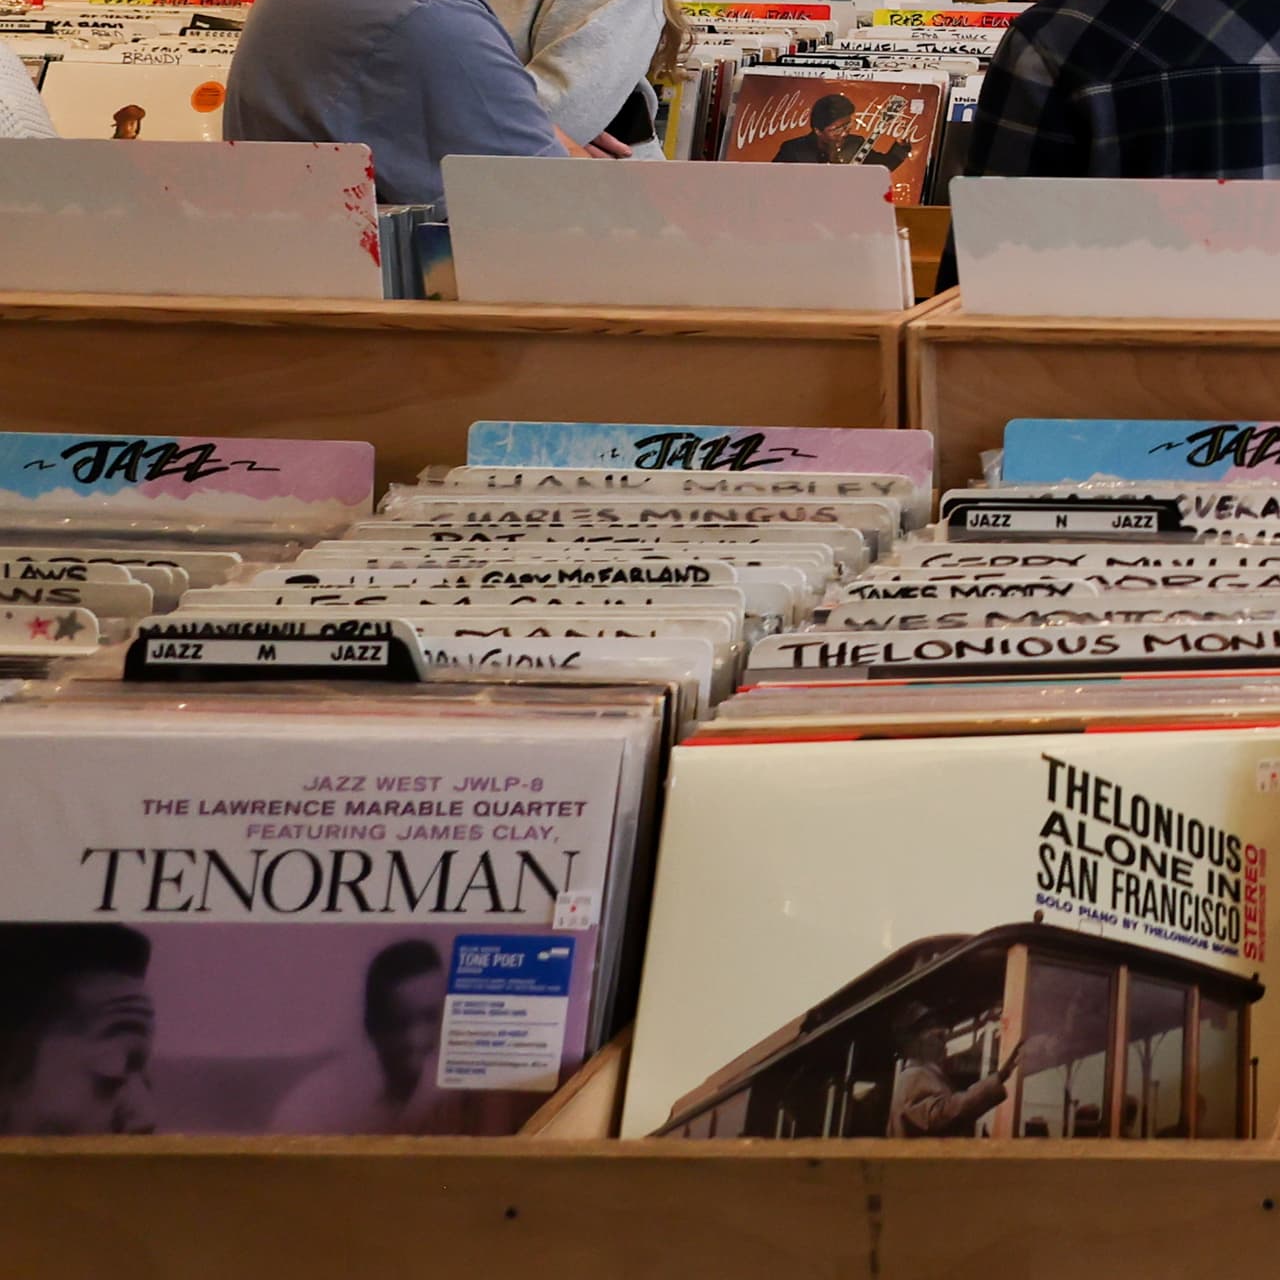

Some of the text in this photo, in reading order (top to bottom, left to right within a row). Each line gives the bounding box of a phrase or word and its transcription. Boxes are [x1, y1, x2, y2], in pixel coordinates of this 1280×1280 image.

[122, 52, 182, 64] BRANDY
[840, 41, 991, 55] MICHAEL JACKSON
[736, 91, 810, 149] Willie
[62, 440, 229, 483] JAZZ
[634, 432, 784, 471] JAZZ
[969, 514, 1154, 529] JAZZ N JAZZ
[152, 643, 382, 661] JAZZ M JAZZ
[779, 635, 1119, 668] THELONIOUS
[303, 776, 545, 792] JAZZ WEST JWLP-8
[142, 799, 588, 818] THE LAWRENCE MARABLE QUARTET
[1041, 752, 1241, 874] THELONIOUS
[246, 824, 561, 844] FEATURING JAMES CLAY,
[1039, 810, 1241, 903] ALONE IN
[80, 849, 581, 914] TENORMAN
[1037, 843, 1098, 904] SAN
[1112, 867, 1240, 945] FRANCISCO
[1036, 893, 1140, 931] SOLO PIANO BY
[1244, 843, 1259, 960] STEREO
[460, 953, 525, 967] TONE POET
